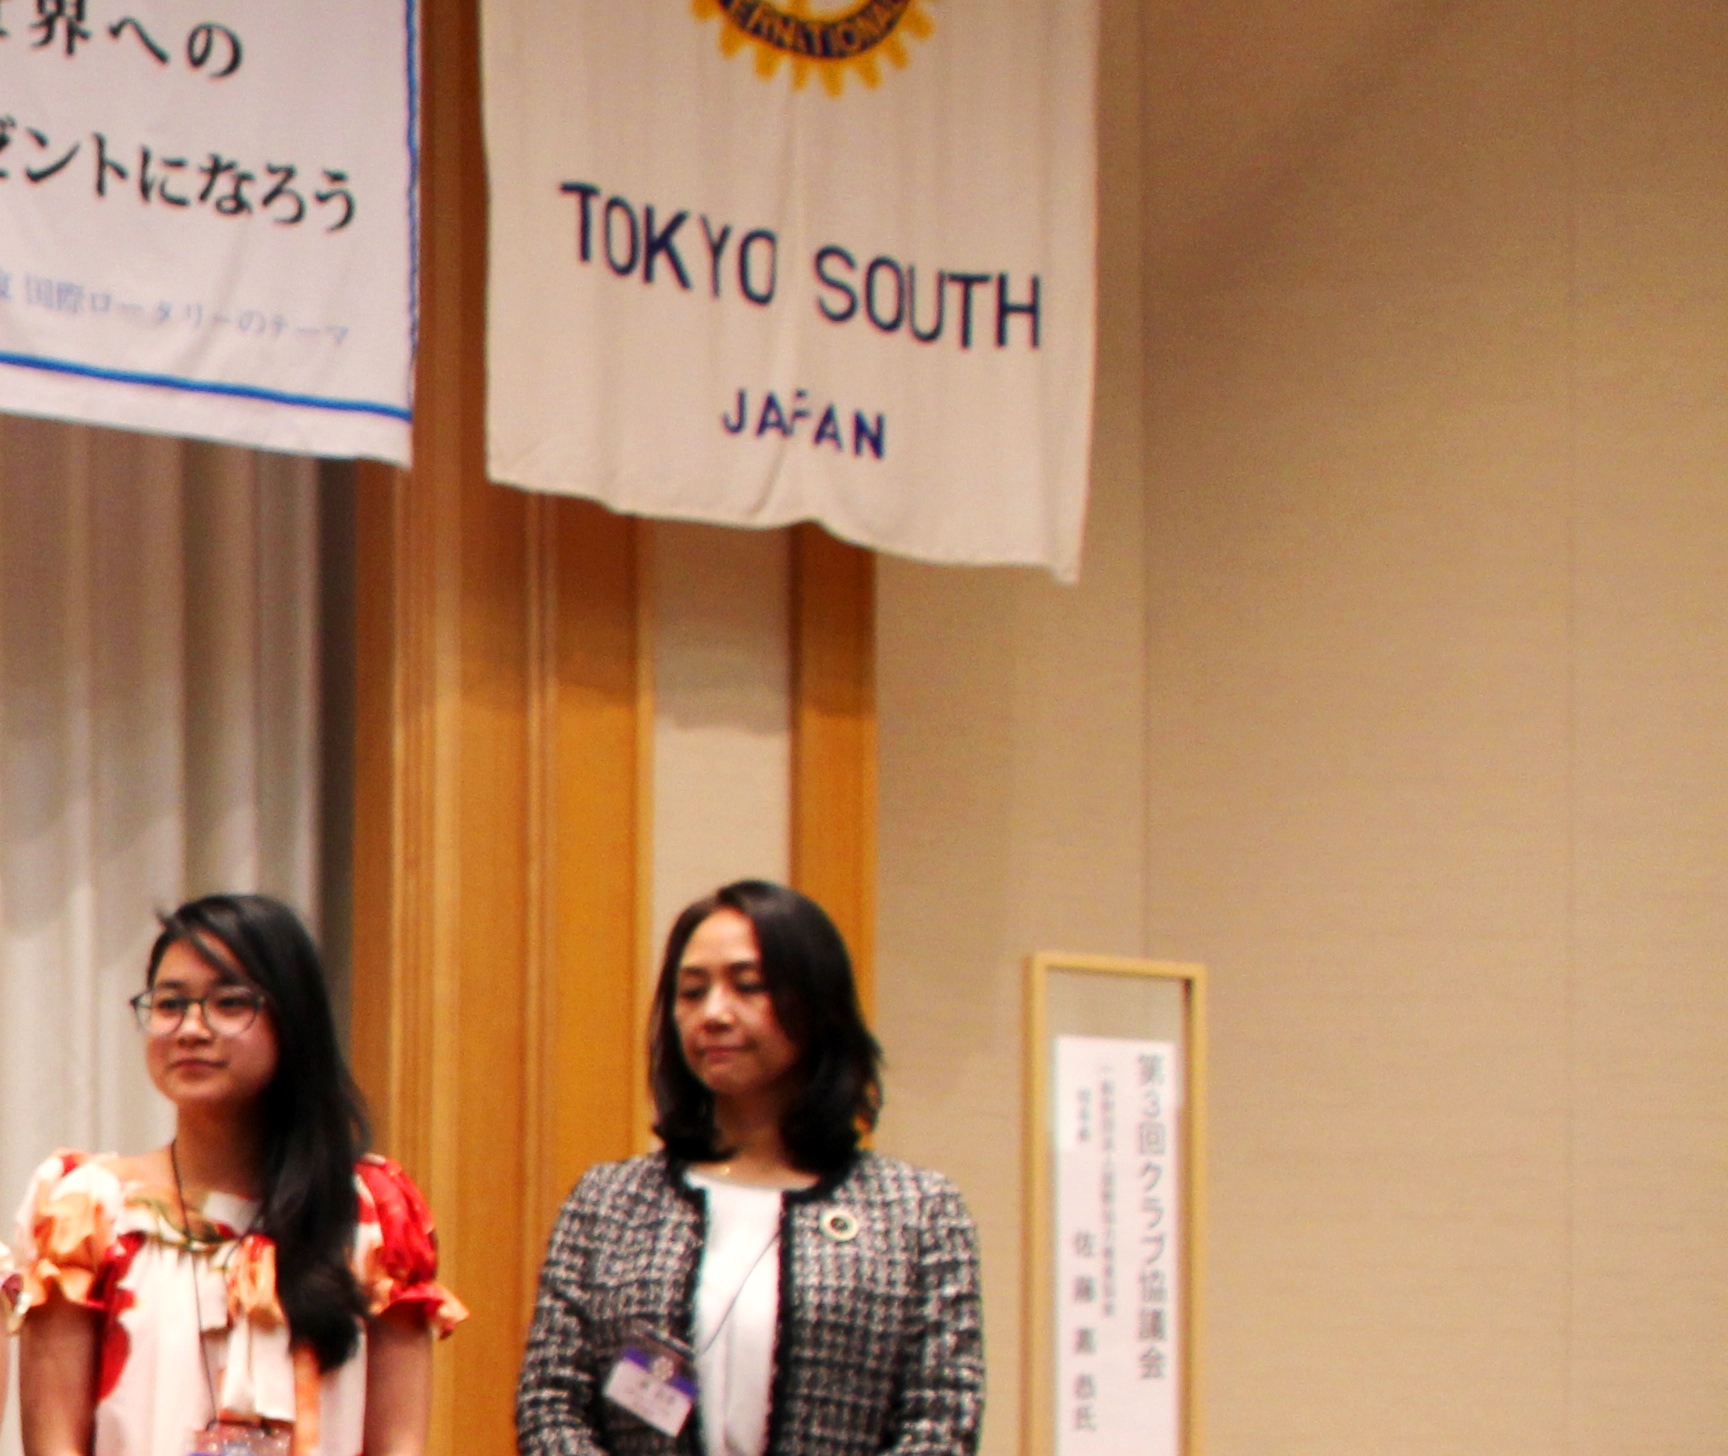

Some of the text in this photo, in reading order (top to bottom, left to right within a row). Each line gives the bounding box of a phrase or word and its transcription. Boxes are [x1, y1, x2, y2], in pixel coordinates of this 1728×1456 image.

[559, 181, 1041, 349] TOKYO SOUTH
[25, 273, 351, 346] 国際ロータリーのテーマ
[722, 389, 886, 460] JAPAN
